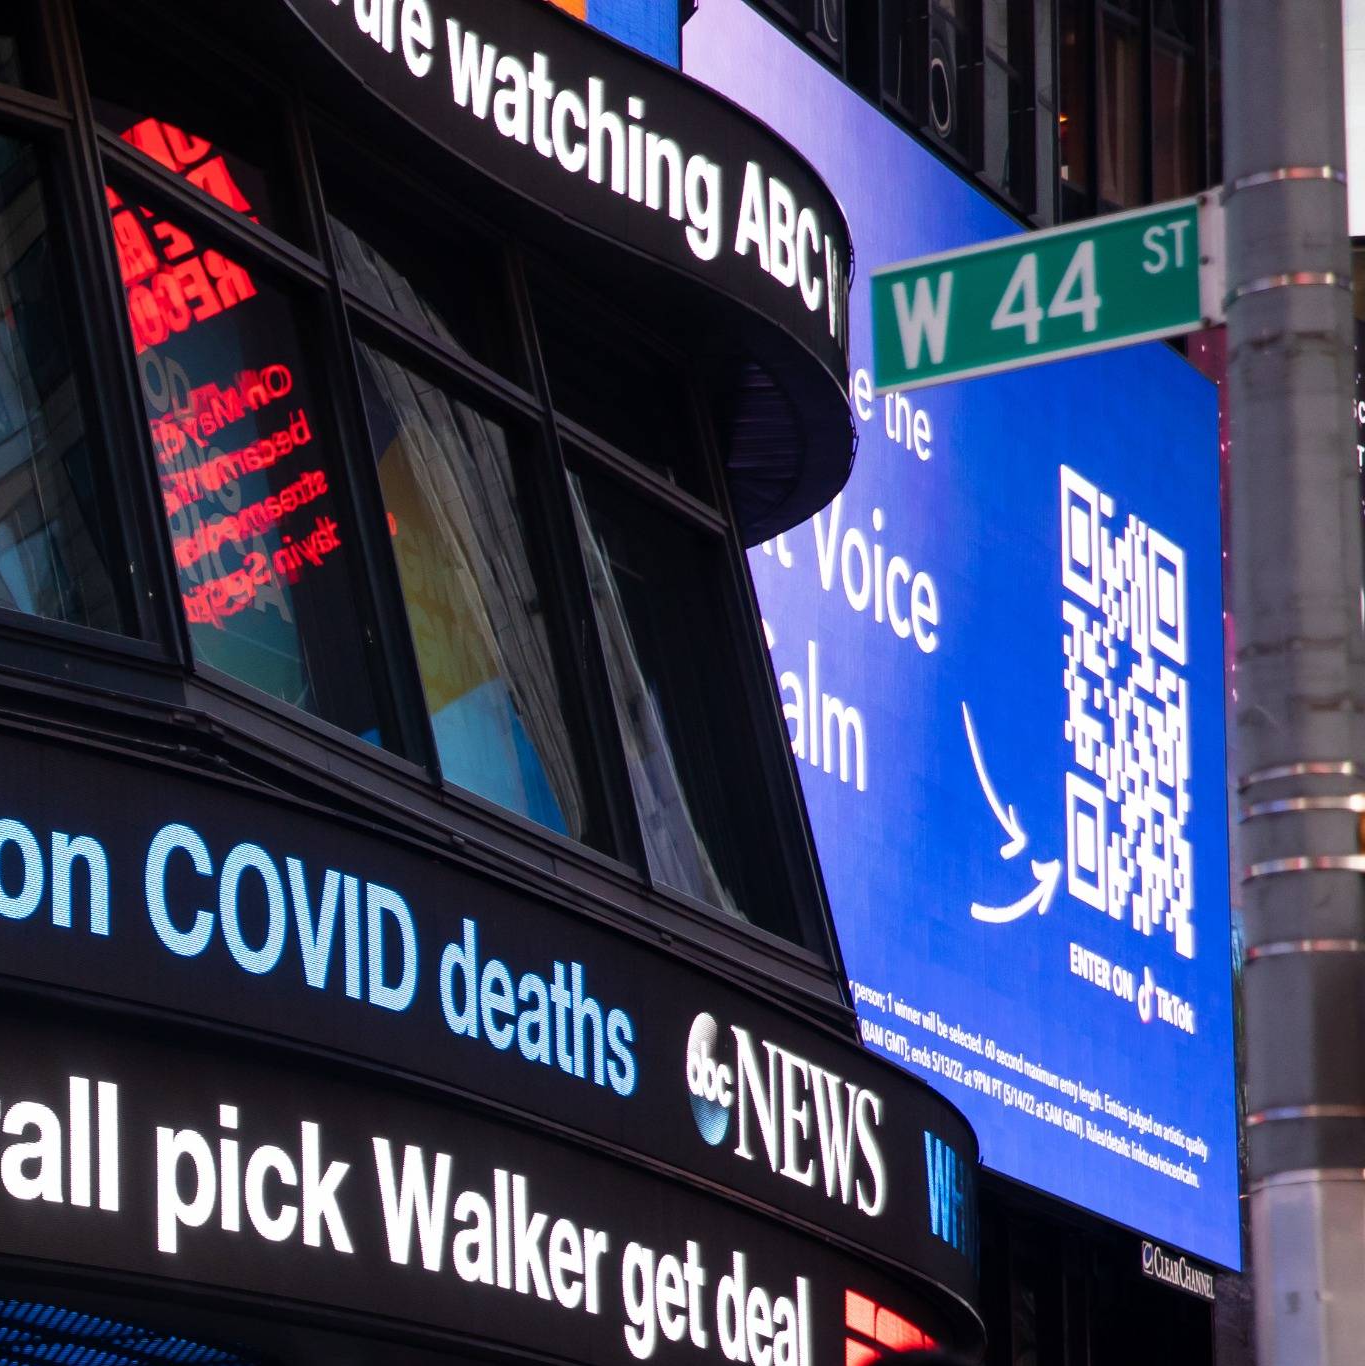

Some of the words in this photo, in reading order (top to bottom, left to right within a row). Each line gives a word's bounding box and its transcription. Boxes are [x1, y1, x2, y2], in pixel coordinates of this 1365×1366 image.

[446, 18, 721, 261] watching
[734, 161, 821, 311] ABC
[892, 271, 953, 370] W
[991, 241, 1102, 345] 44
[1142, 219, 1191, 274] ST
[812, 492, 940, 653] Voice
[762, 619, 868, 792] alm
[144, 823, 419, 1012] COVID
[439, 918, 638, 1096] deaths
[1070, 942, 1110, 991] ENTER
[1112, 965, 1133, 1002] ON
[1155, 986, 1195, 1034] TikTok
[687, 1041, 732, 1108] abc
[731, 1025, 886, 1217] NEWS
[887, 992, 892, 1013] 1
[894, 998, 921, 1026] winner
[922, 1011, 937, 1033] will
[937, 1014, 949, 1039] be
[949, 1024, 983, 1055] selected.
[985, 1039, 995, 1060] 60
[996, 1053, 1023, 1074] second
[1024, 1062, 1059, 1090] maximum
[1060, 1078, 1078, 1103] entry
[1105, 1094, 1127, 1122] Entries
[1129, 1105, 1152, 1135] judged
[1154, 1122, 1162, 1138] on
[1186, 1136, 1208, 1163] quality
[912, 1046, 931, 1069] ends
[932, 1050, 963, 1083] 5/13/22
[964, 1069, 972, 1088] at
[973, 1070, 990, 1095] 9PM
[992, 1078, 1002, 1100] PT
[1036, 1101, 1044, 1120] at
[1045, 1102, 1062, 1128] 5AM
[156, 1104, 354, 1254] pick
[372, 1137, 609, 1314] Walker
[622, 1240, 708, 1359] get
